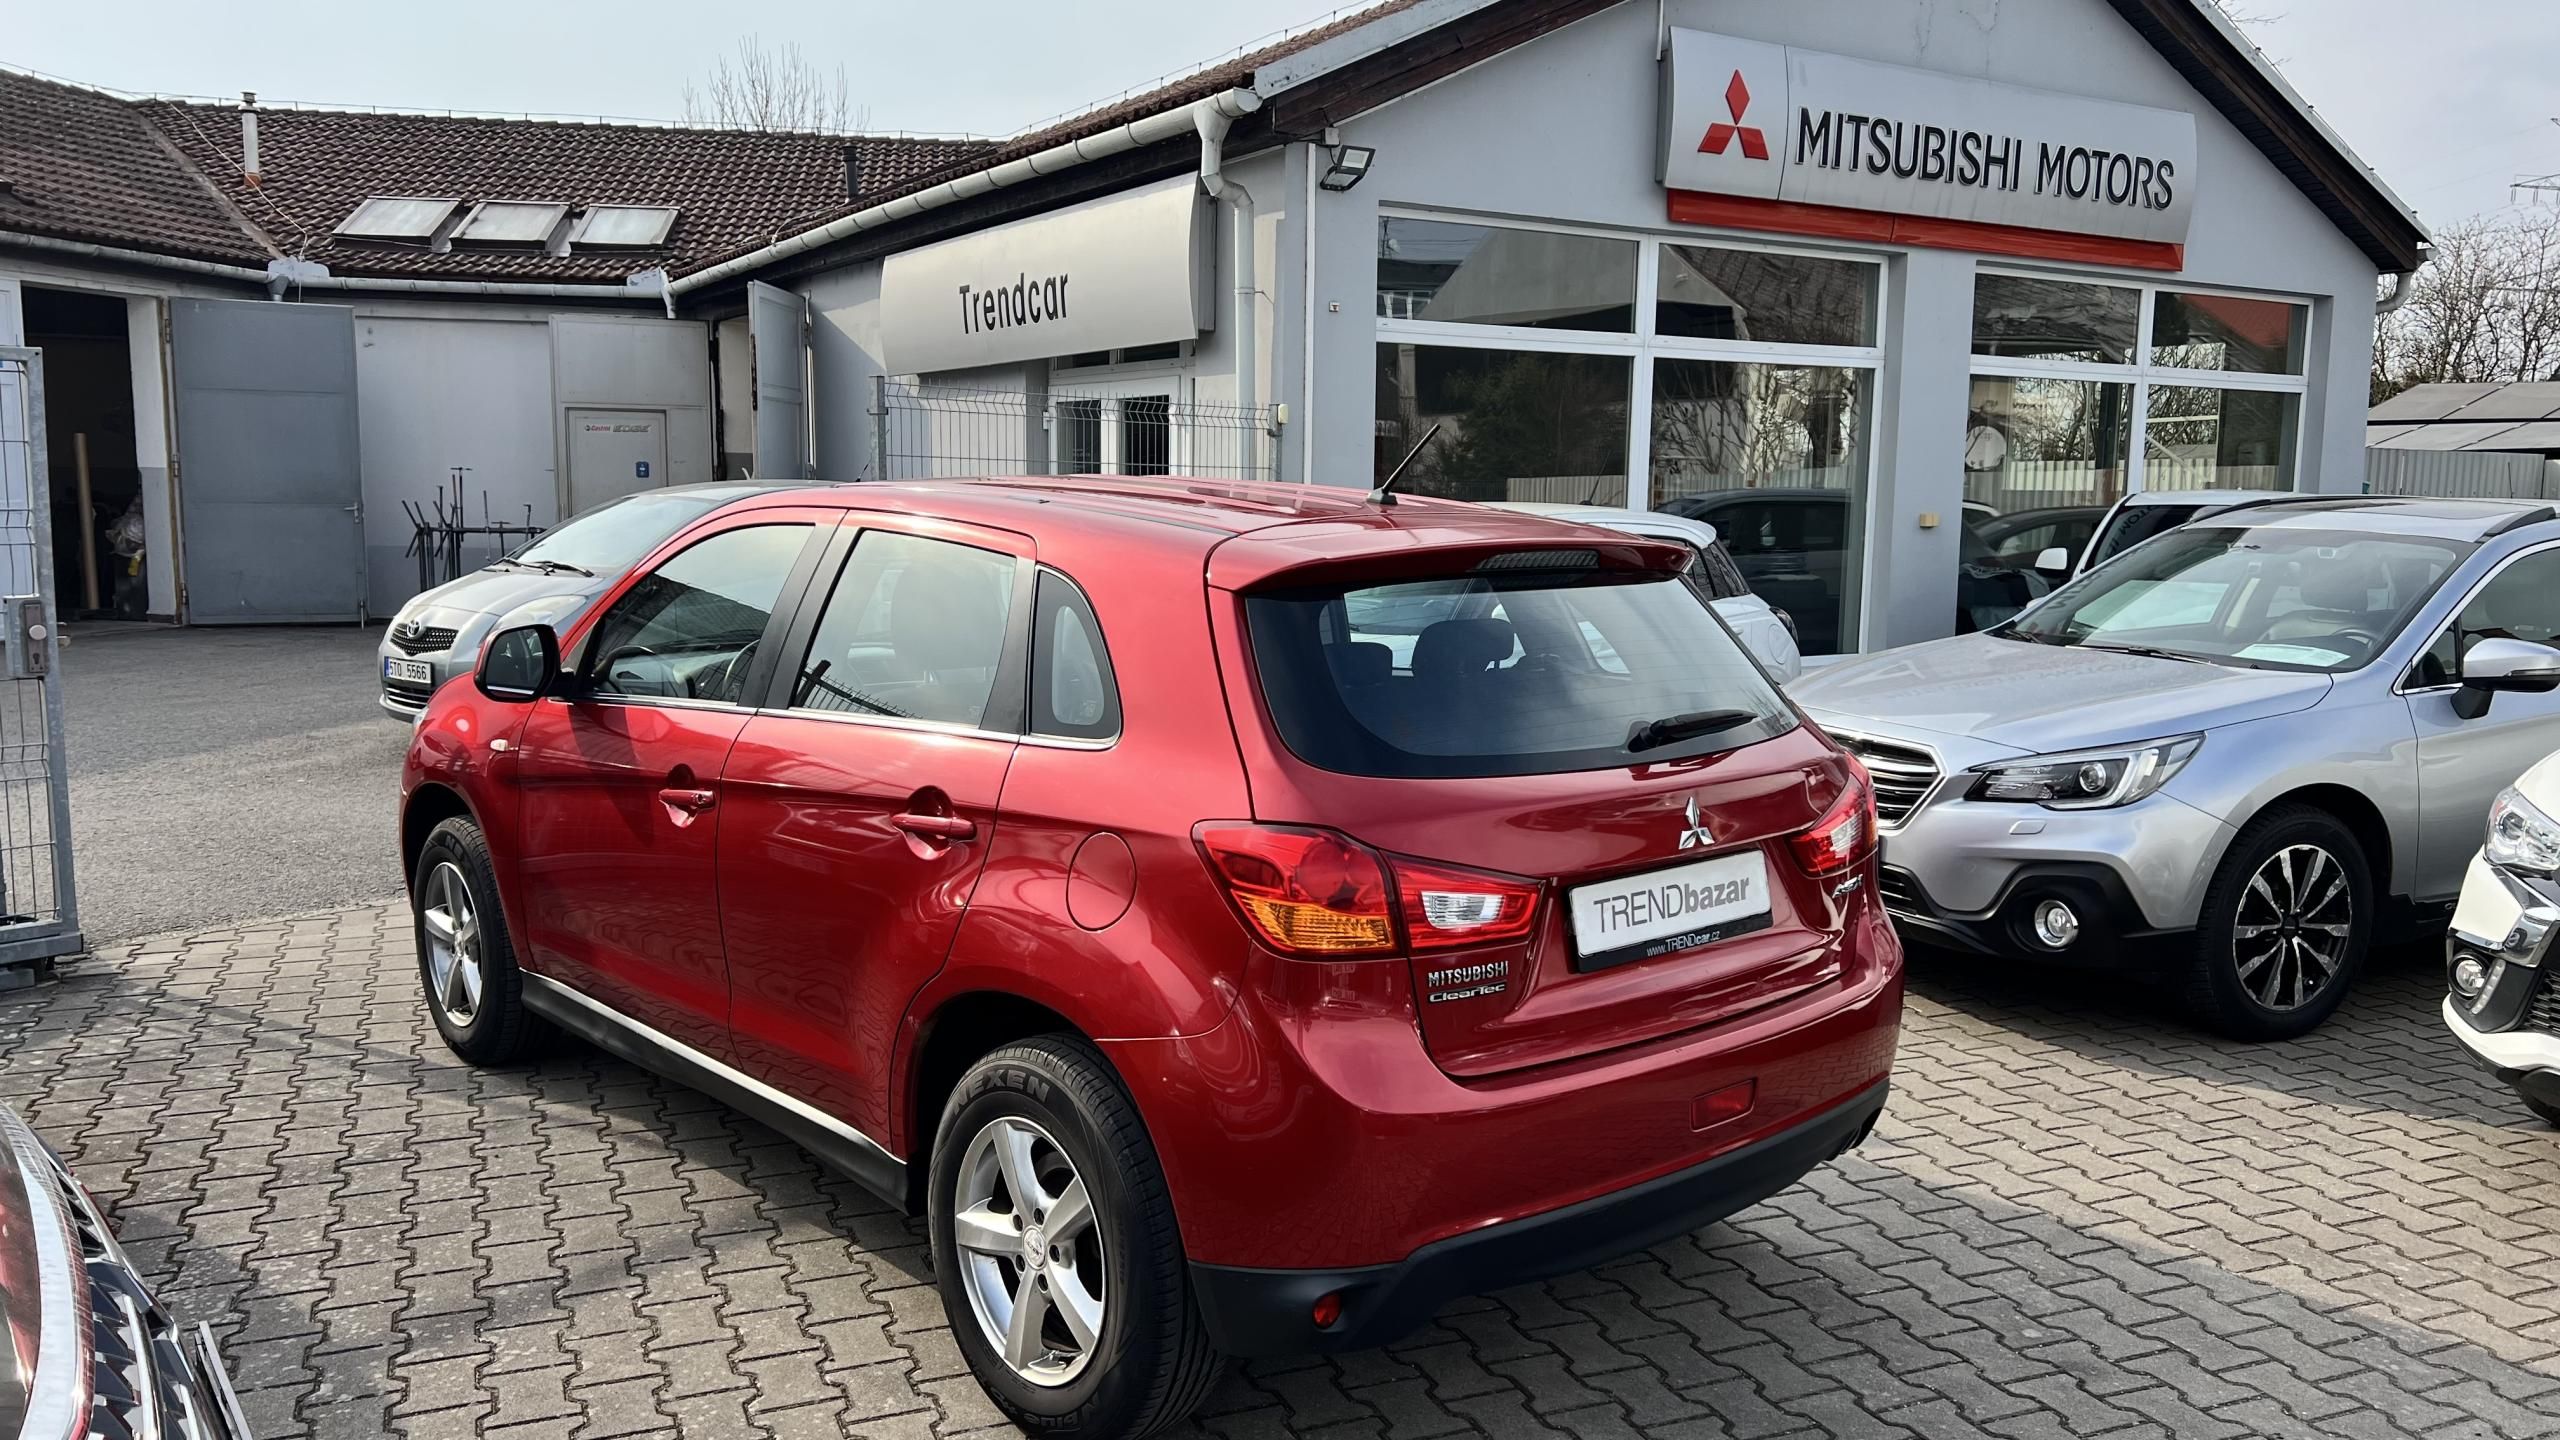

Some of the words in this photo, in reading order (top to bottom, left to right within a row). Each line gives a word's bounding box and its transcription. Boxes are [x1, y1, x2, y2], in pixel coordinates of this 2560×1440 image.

[1795, 106, 2022, 192] MITSUBISHI
[2034, 141, 2174, 211] MOTORS
[959, 272, 1068, 334] Trendcar
[406, 663, 427, 680] 5566
[1593, 877, 1750, 933] TRENDbazar
[1428, 960, 1509, 987] MITSUBISHI
[1429, 984, 1505, 1003] ClearTec
[951, 1069, 1050, 1116] NEXEN
